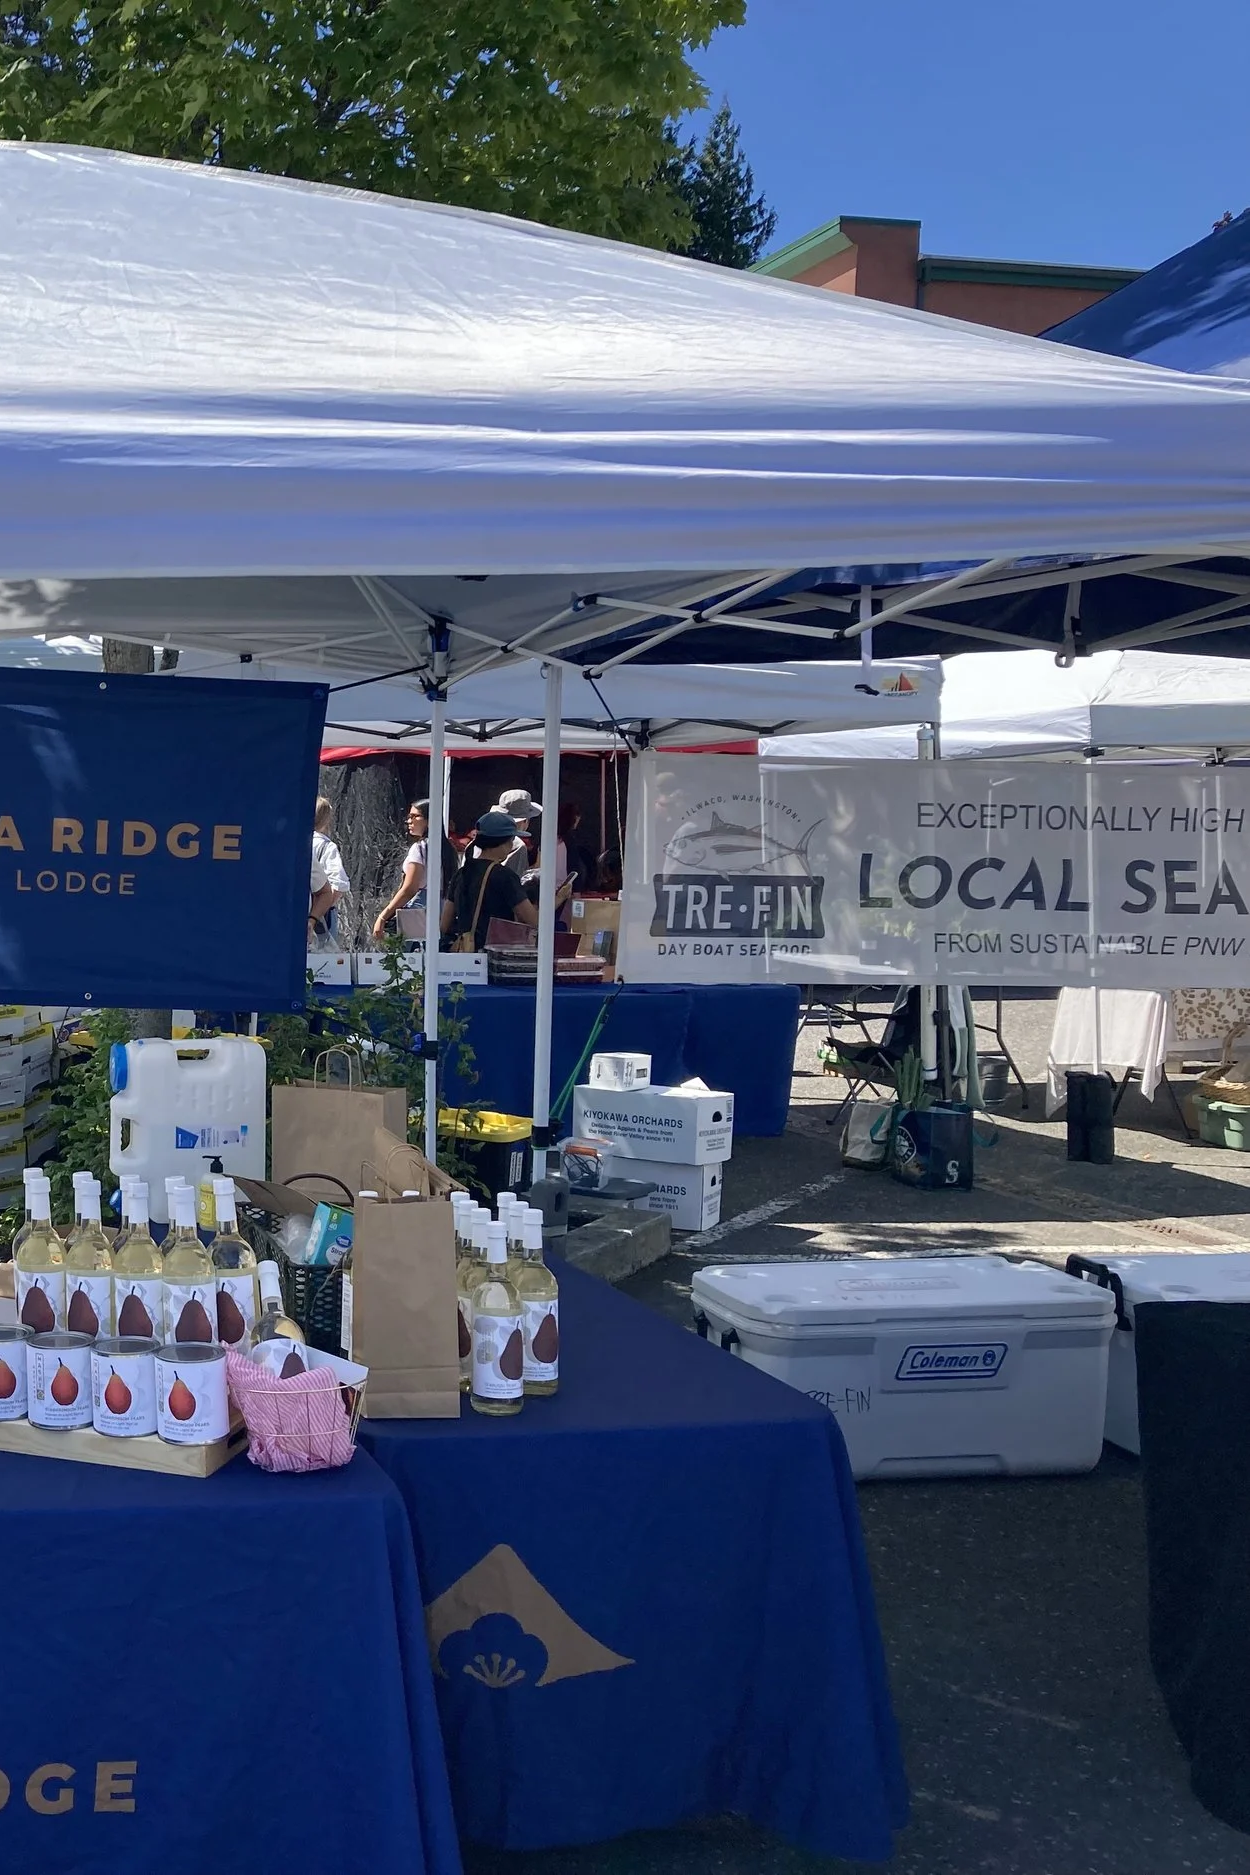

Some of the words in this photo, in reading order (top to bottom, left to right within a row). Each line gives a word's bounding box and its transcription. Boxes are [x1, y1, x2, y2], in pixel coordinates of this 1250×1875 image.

[685, 795, 726, 817] ILWACO,
[732, 793, 798, 821] WASHINGTON
[916, 802, 1162, 832] EXCEPTIONALLY
[1169, 806, 1245, 833] HIGH
[51, 816, 244, 861] RIDGE
[16, 868, 136, 896] LODGE
[859, 852, 1092, 911] LOCAL
[1120, 857, 1249, 915] SEA
[657, 943, 687, 956] DAY
[693, 943, 734, 956] BOAT
[739, 944, 810, 957] SEAFOOD
[933, 932, 1003, 954] FROM
[1009, 933, 1178, 956] SUSTANABLE
[1184, 935, 1246, 956] PNW
[583, 1110, 629, 1123] KIYOKAWA
[632, 1115, 683, 1129] ORCHARDS
[629, 1132, 645, 1140] Valley
[910, 1350, 980, 1370] Coleman
